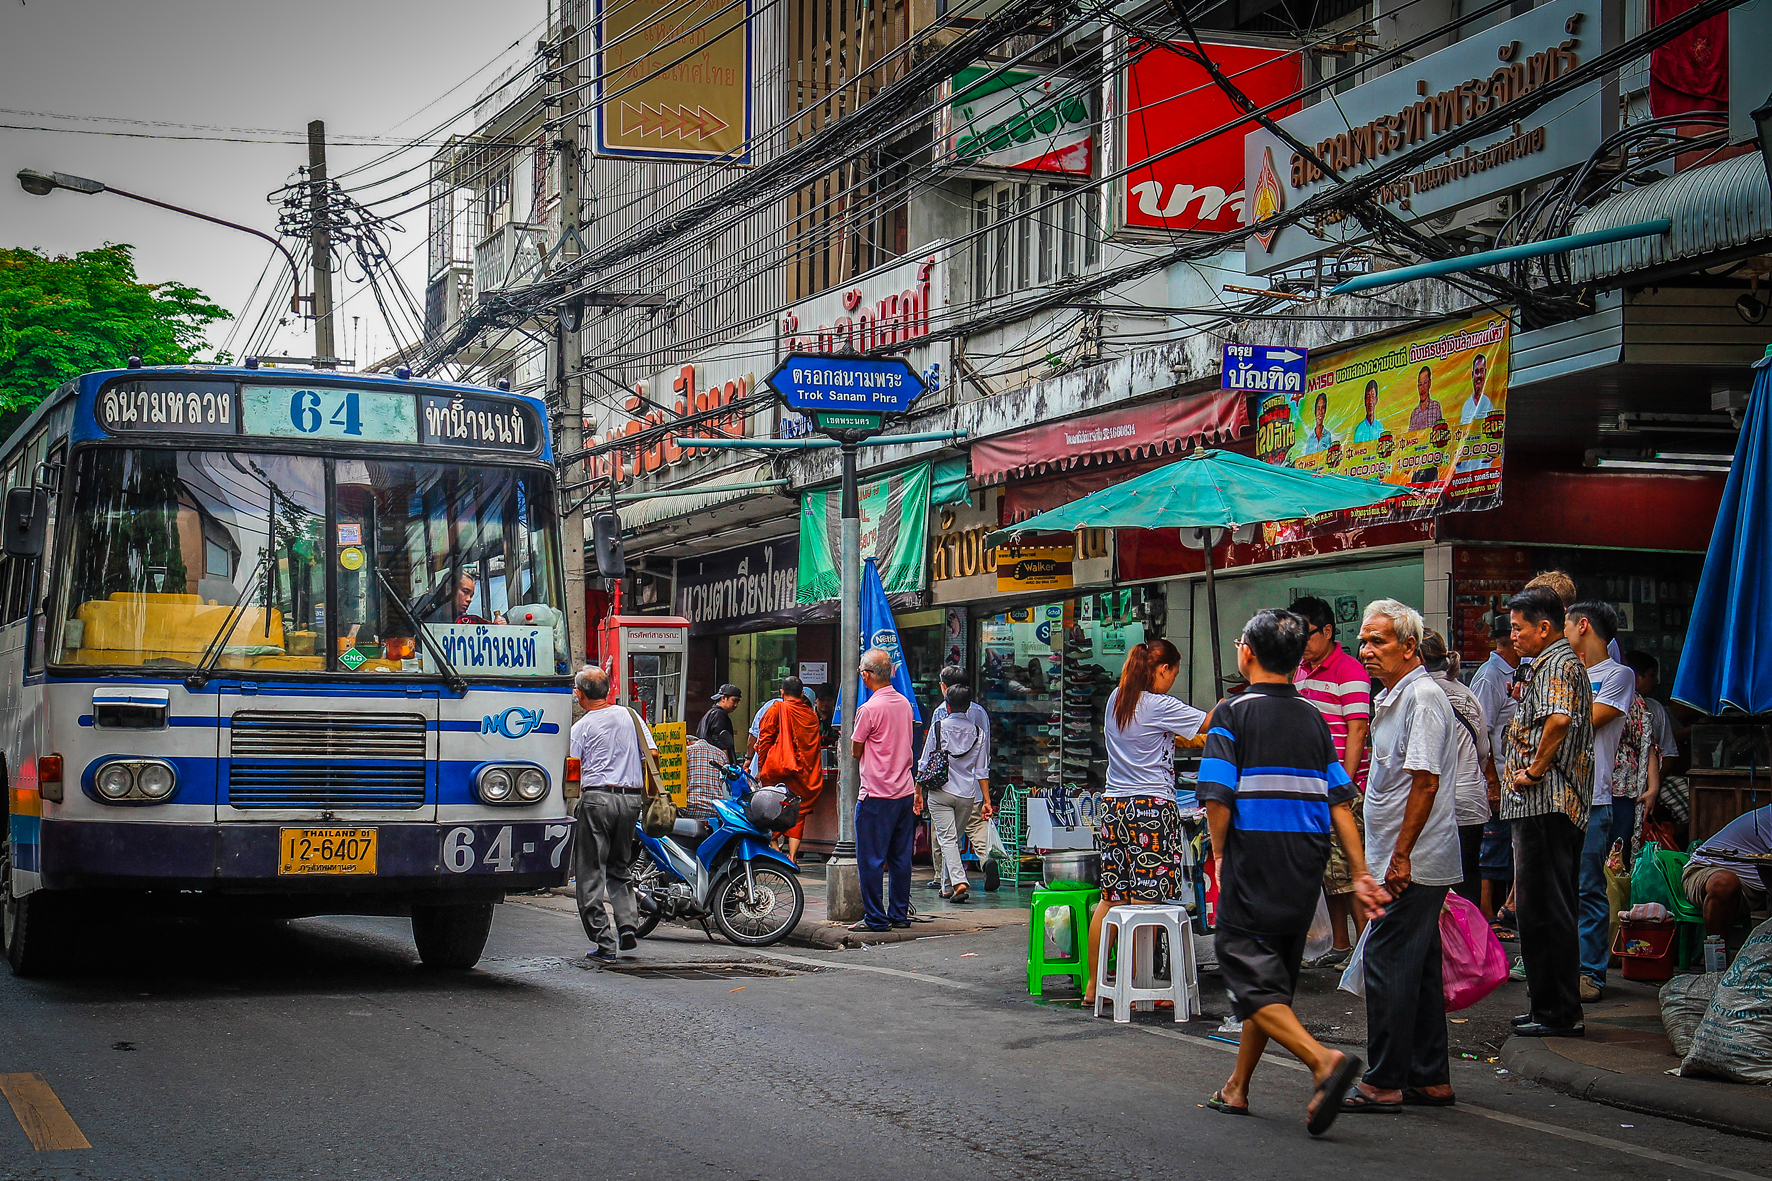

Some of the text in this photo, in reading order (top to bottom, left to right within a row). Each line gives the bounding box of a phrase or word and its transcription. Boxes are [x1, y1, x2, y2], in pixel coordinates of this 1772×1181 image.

[792, 368, 902, 388] ตรอกสนามพระ
[1228, 362, 1301, 391] บัณฑิต
[103, 388, 231, 424] สนามหลวง
[797, 390, 898, 404] Trok Sanam Phra
[290, 390, 363, 436] 64
[1023, 562, 1056, 572] Walker
[683, 545, 798, 623] แว่นตาเวียงไทย
[1047, 608, 1061, 616] Scholl
[442, 626, 539, 667] ท่าน้ำนนท์
[481, 706, 545, 740] NGV
[289, 837, 372, 861] 12-6407
[443, 825, 572, 873] 64-7
